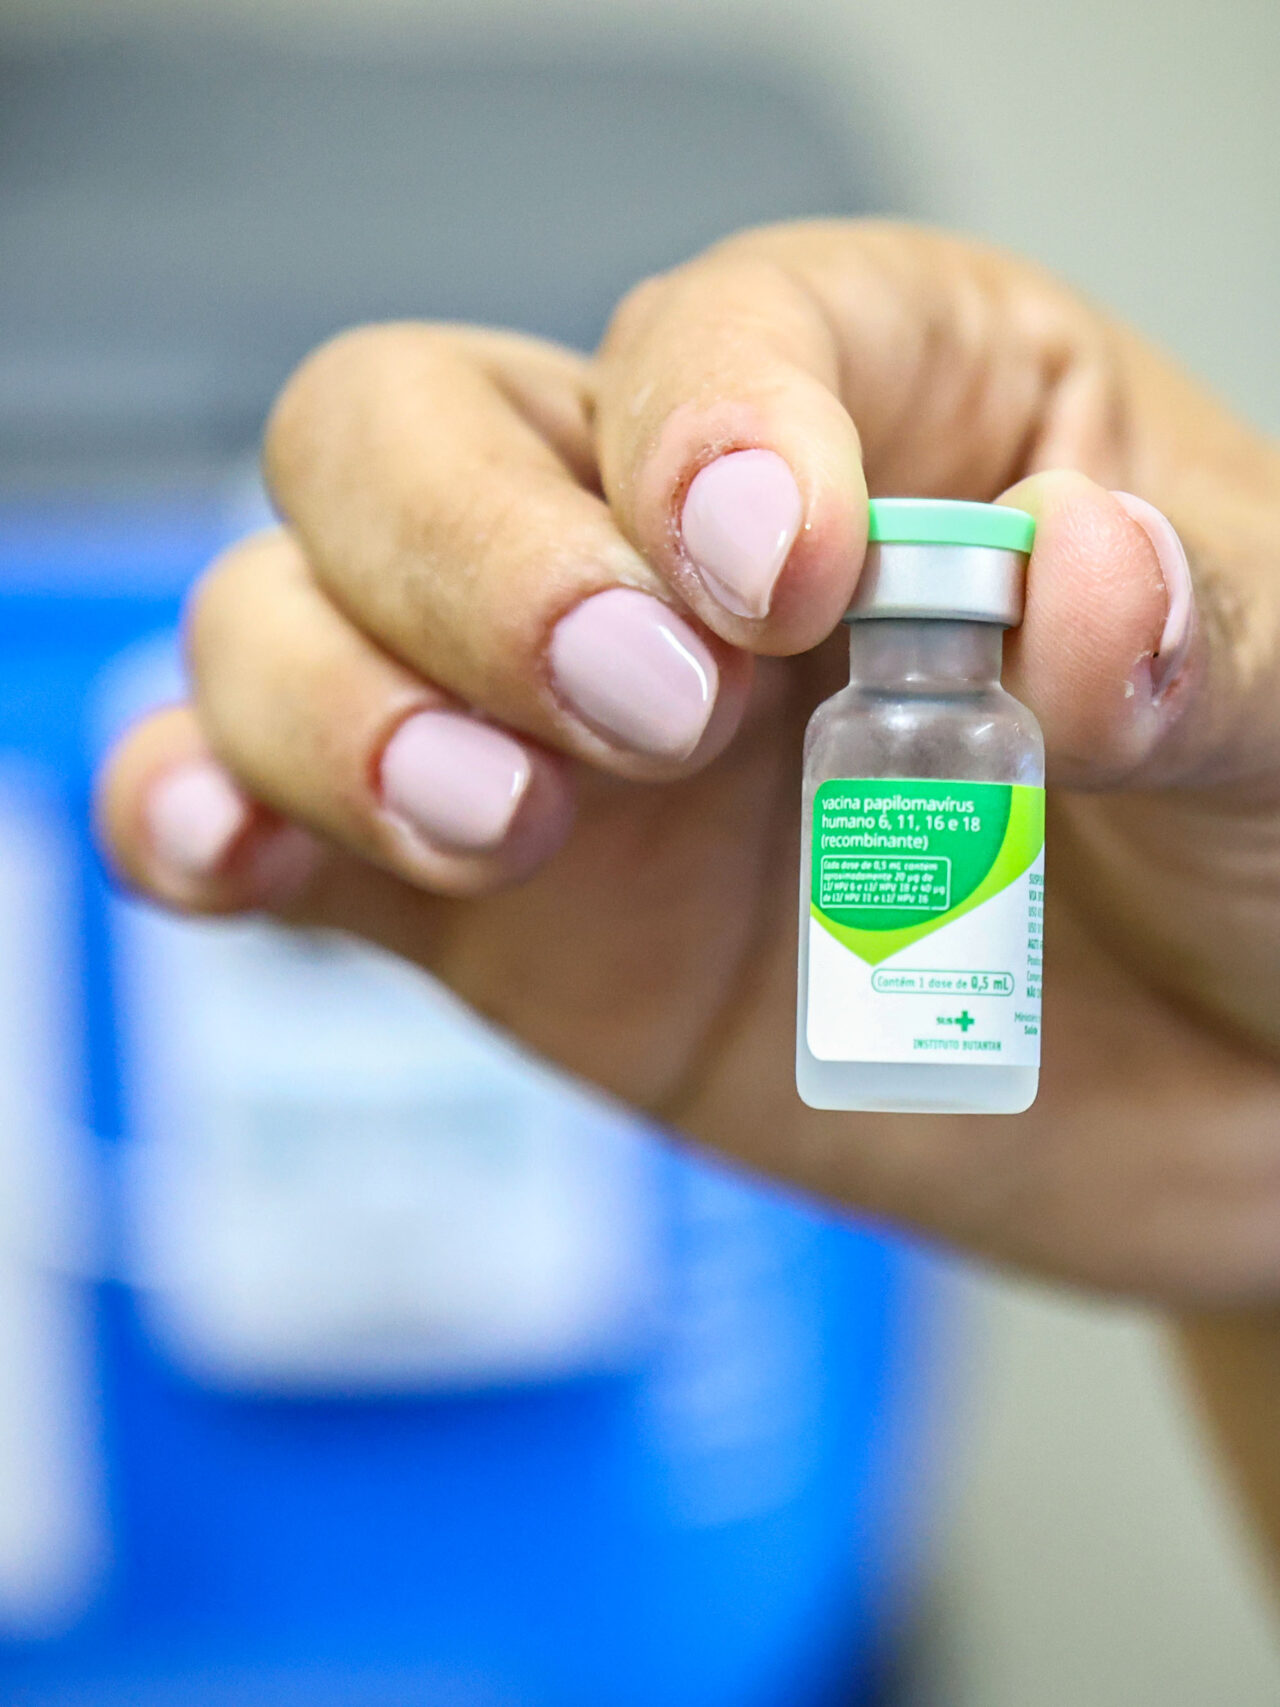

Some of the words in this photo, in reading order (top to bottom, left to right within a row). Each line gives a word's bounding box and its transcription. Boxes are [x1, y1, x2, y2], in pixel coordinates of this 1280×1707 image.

[822, 795, 860, 811] vacina
[864, 795, 975, 814] papilomavírus
[822, 814, 875, 830] humano
[878, 814, 892, 831] 6,
[897, 813, 920, 832] 11,
[925, 814, 946, 831] 16
[947, 818, 960, 831] e
[962, 815, 981, 832] 18
[820, 833, 929, 851] (recombinante)
[928, 977, 953, 989] dose
[955, 979, 968, 990] de
[970, 975, 989, 992] 0,5
[993, 977, 1009, 991] mL
[912, 1038, 959, 1050] INSTITUTO
